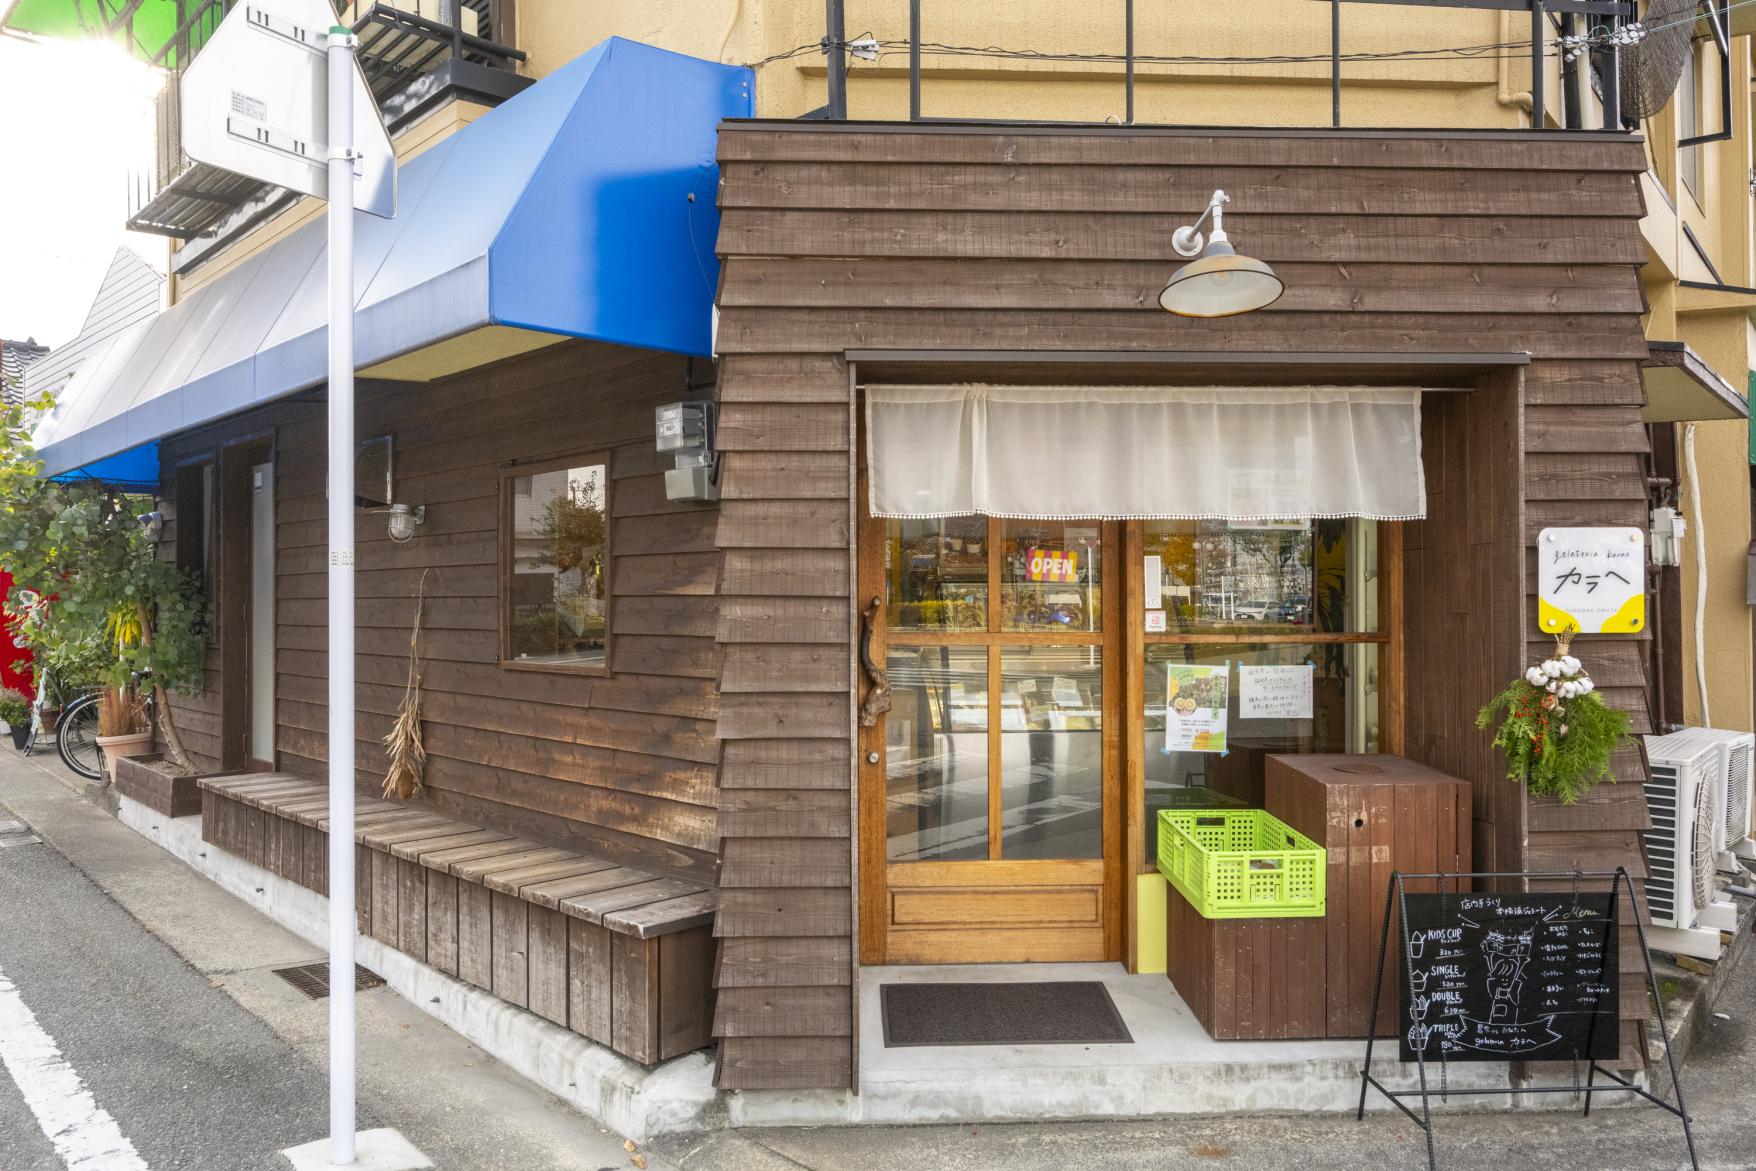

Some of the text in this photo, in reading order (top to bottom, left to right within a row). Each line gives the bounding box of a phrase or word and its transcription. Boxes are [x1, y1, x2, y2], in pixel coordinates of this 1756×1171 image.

[1554, 549, 1630, 564] gelateria karae
[1031, 558, 1074, 574] OPEN
[1428, 929, 1445, 941] KIDS
[1447, 927, 1463, 940] CUP
[1431, 964, 1459, 976] SINGLE
[1431, 991, 1460, 1002] DOUBLE
[1433, 1023, 1459, 1033] TRIPLE
